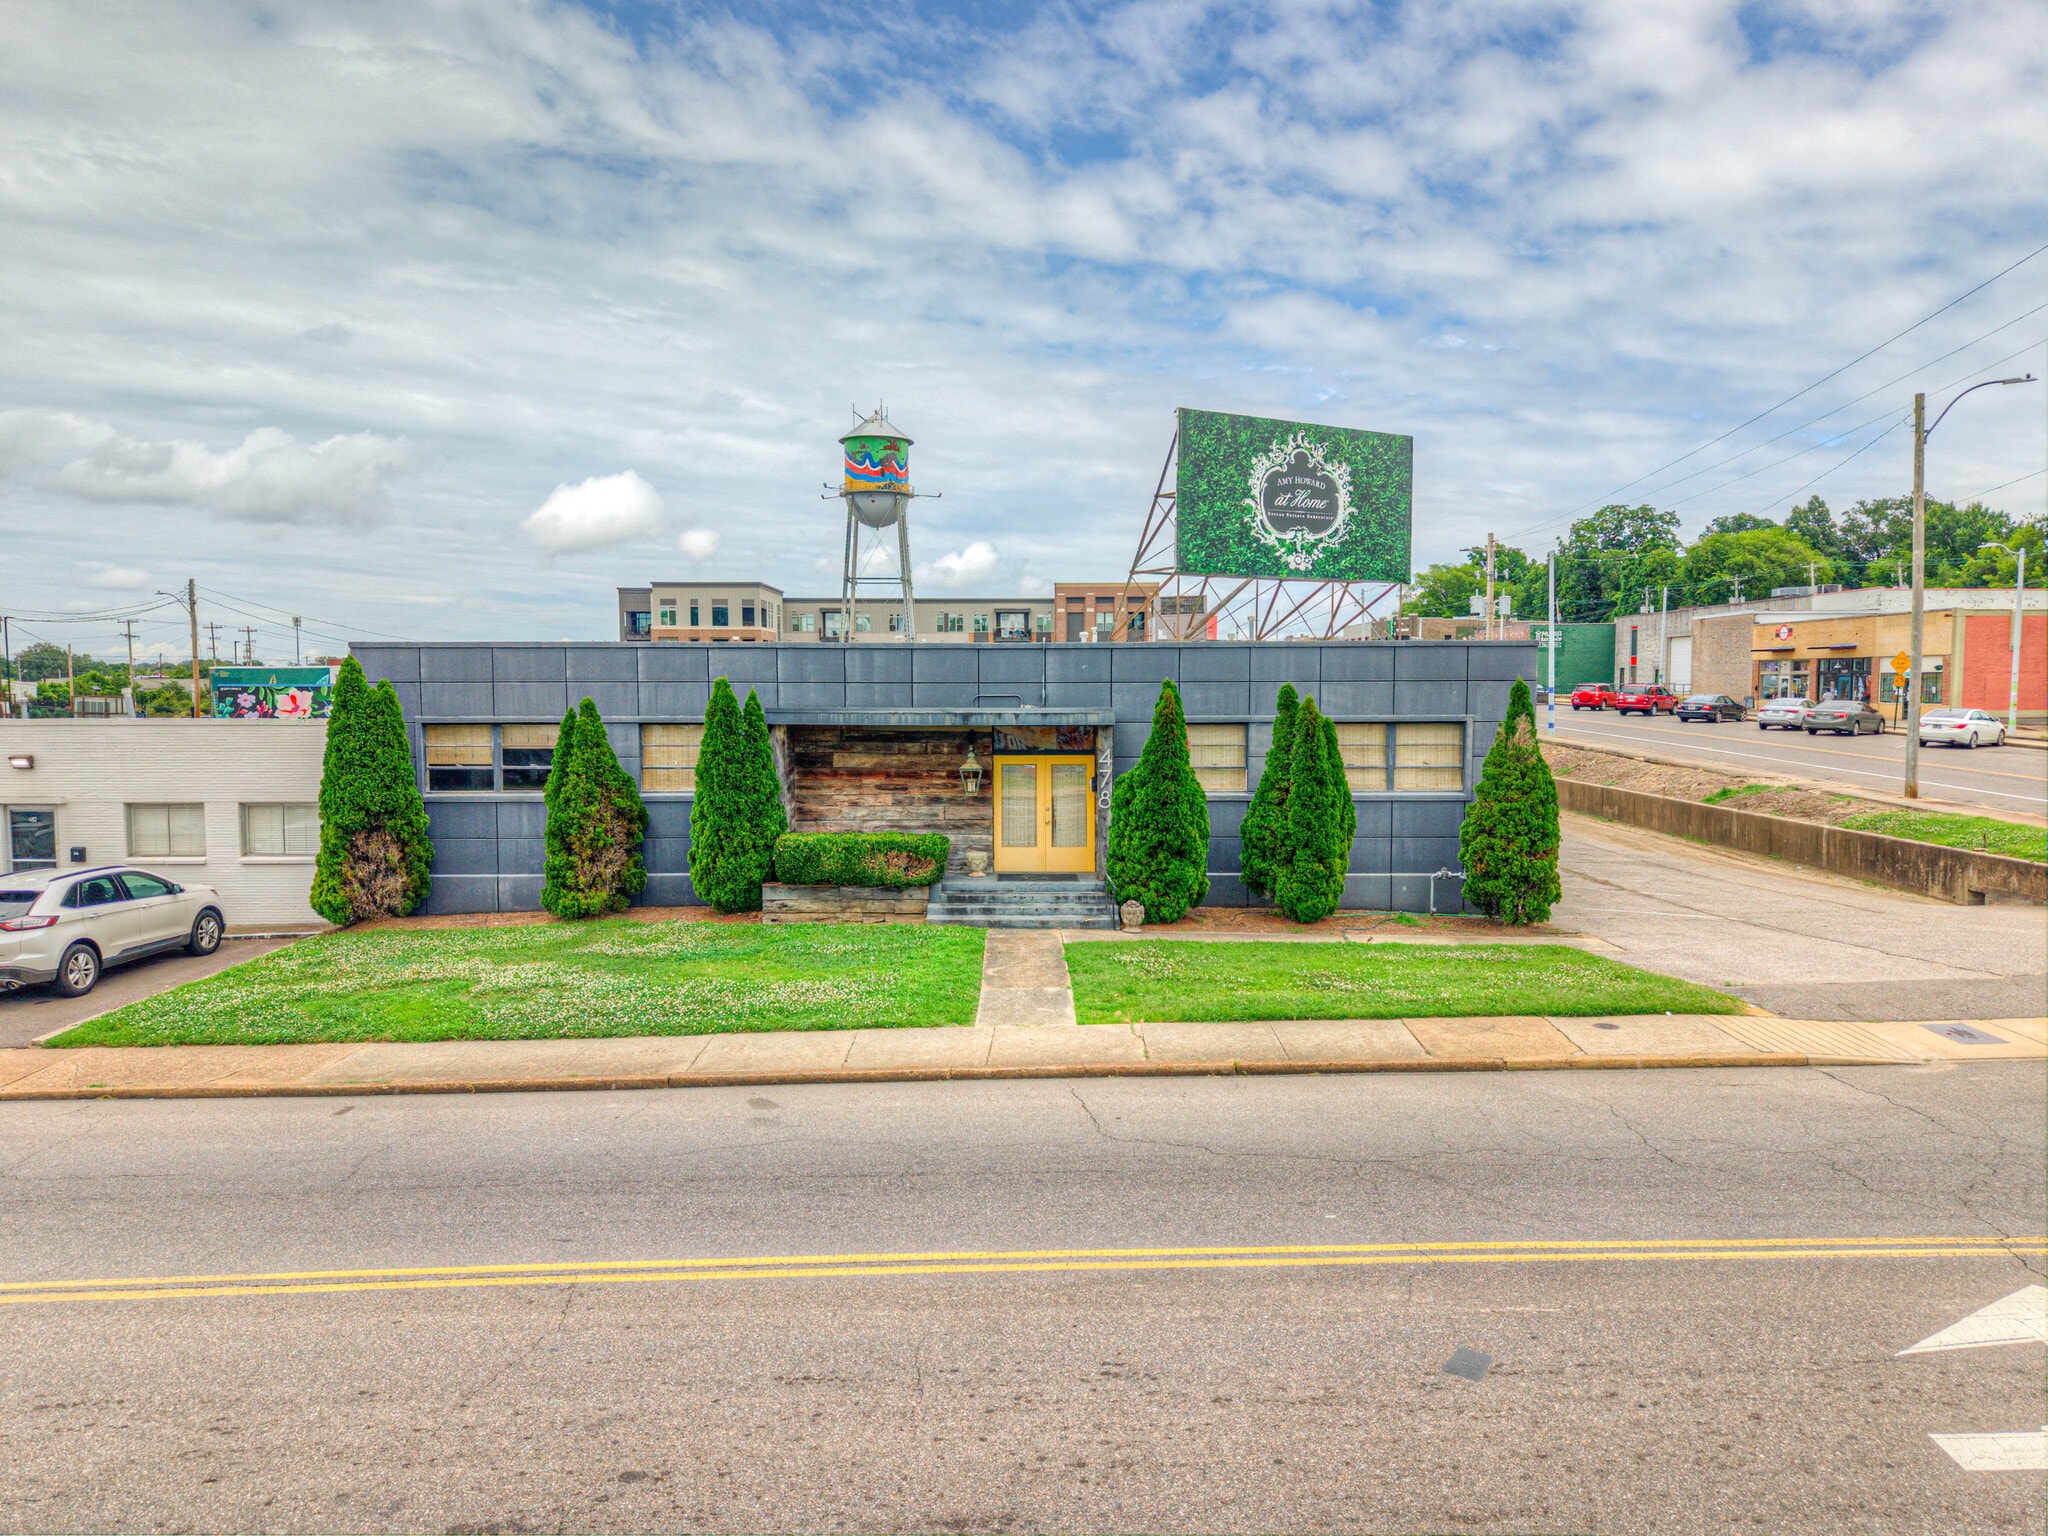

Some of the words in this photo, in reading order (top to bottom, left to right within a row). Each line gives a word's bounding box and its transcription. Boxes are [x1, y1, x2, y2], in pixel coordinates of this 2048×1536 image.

[1277, 476, 1293, 486] AMY
[1294, 476, 1326, 490] HOWARD
[1274, 492, 1293, 506] at
[1290, 489, 1328, 509] Home
[1098, 748, 1113, 809] 478
